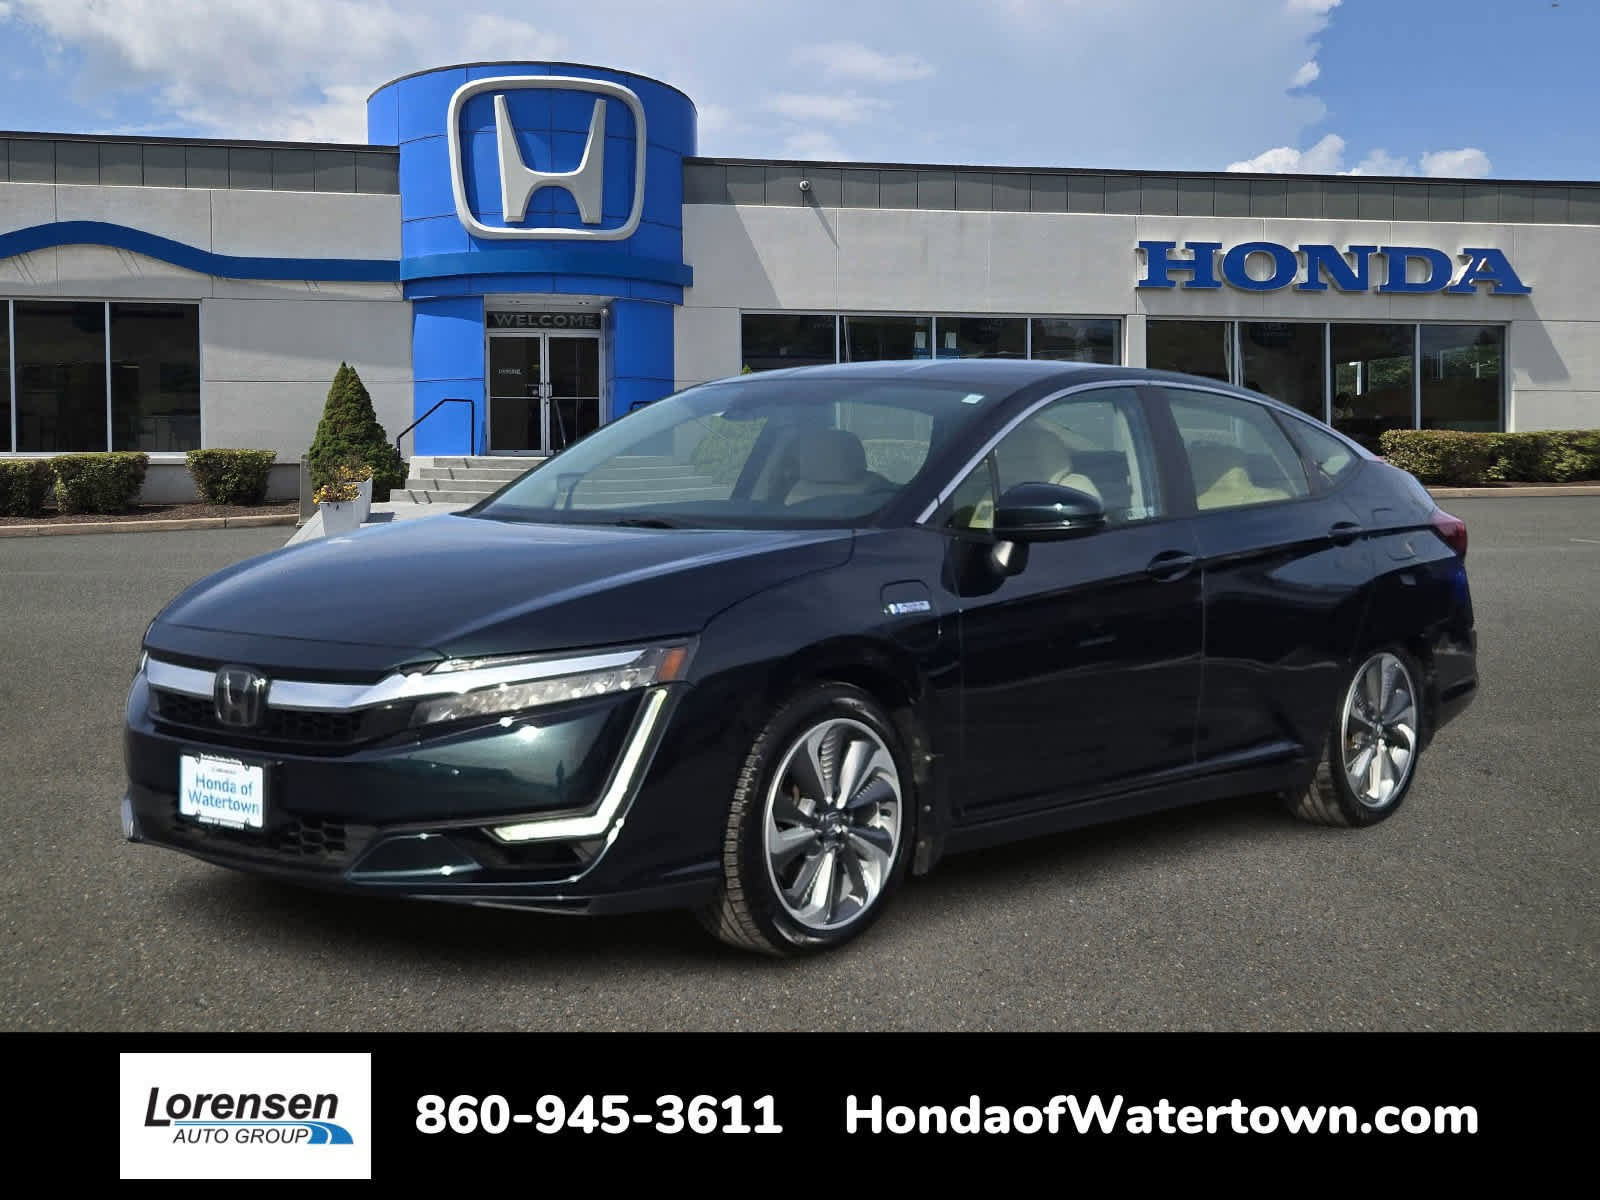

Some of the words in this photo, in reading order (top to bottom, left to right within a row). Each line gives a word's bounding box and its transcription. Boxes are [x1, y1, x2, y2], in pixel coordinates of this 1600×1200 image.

[1136, 240, 1532, 296] HONDA
[493, 312, 598, 328] WELCOME
[195, 772, 237, 794] Honda
[240, 781, 254, 797] of
[187, 789, 260, 816] Watertown
